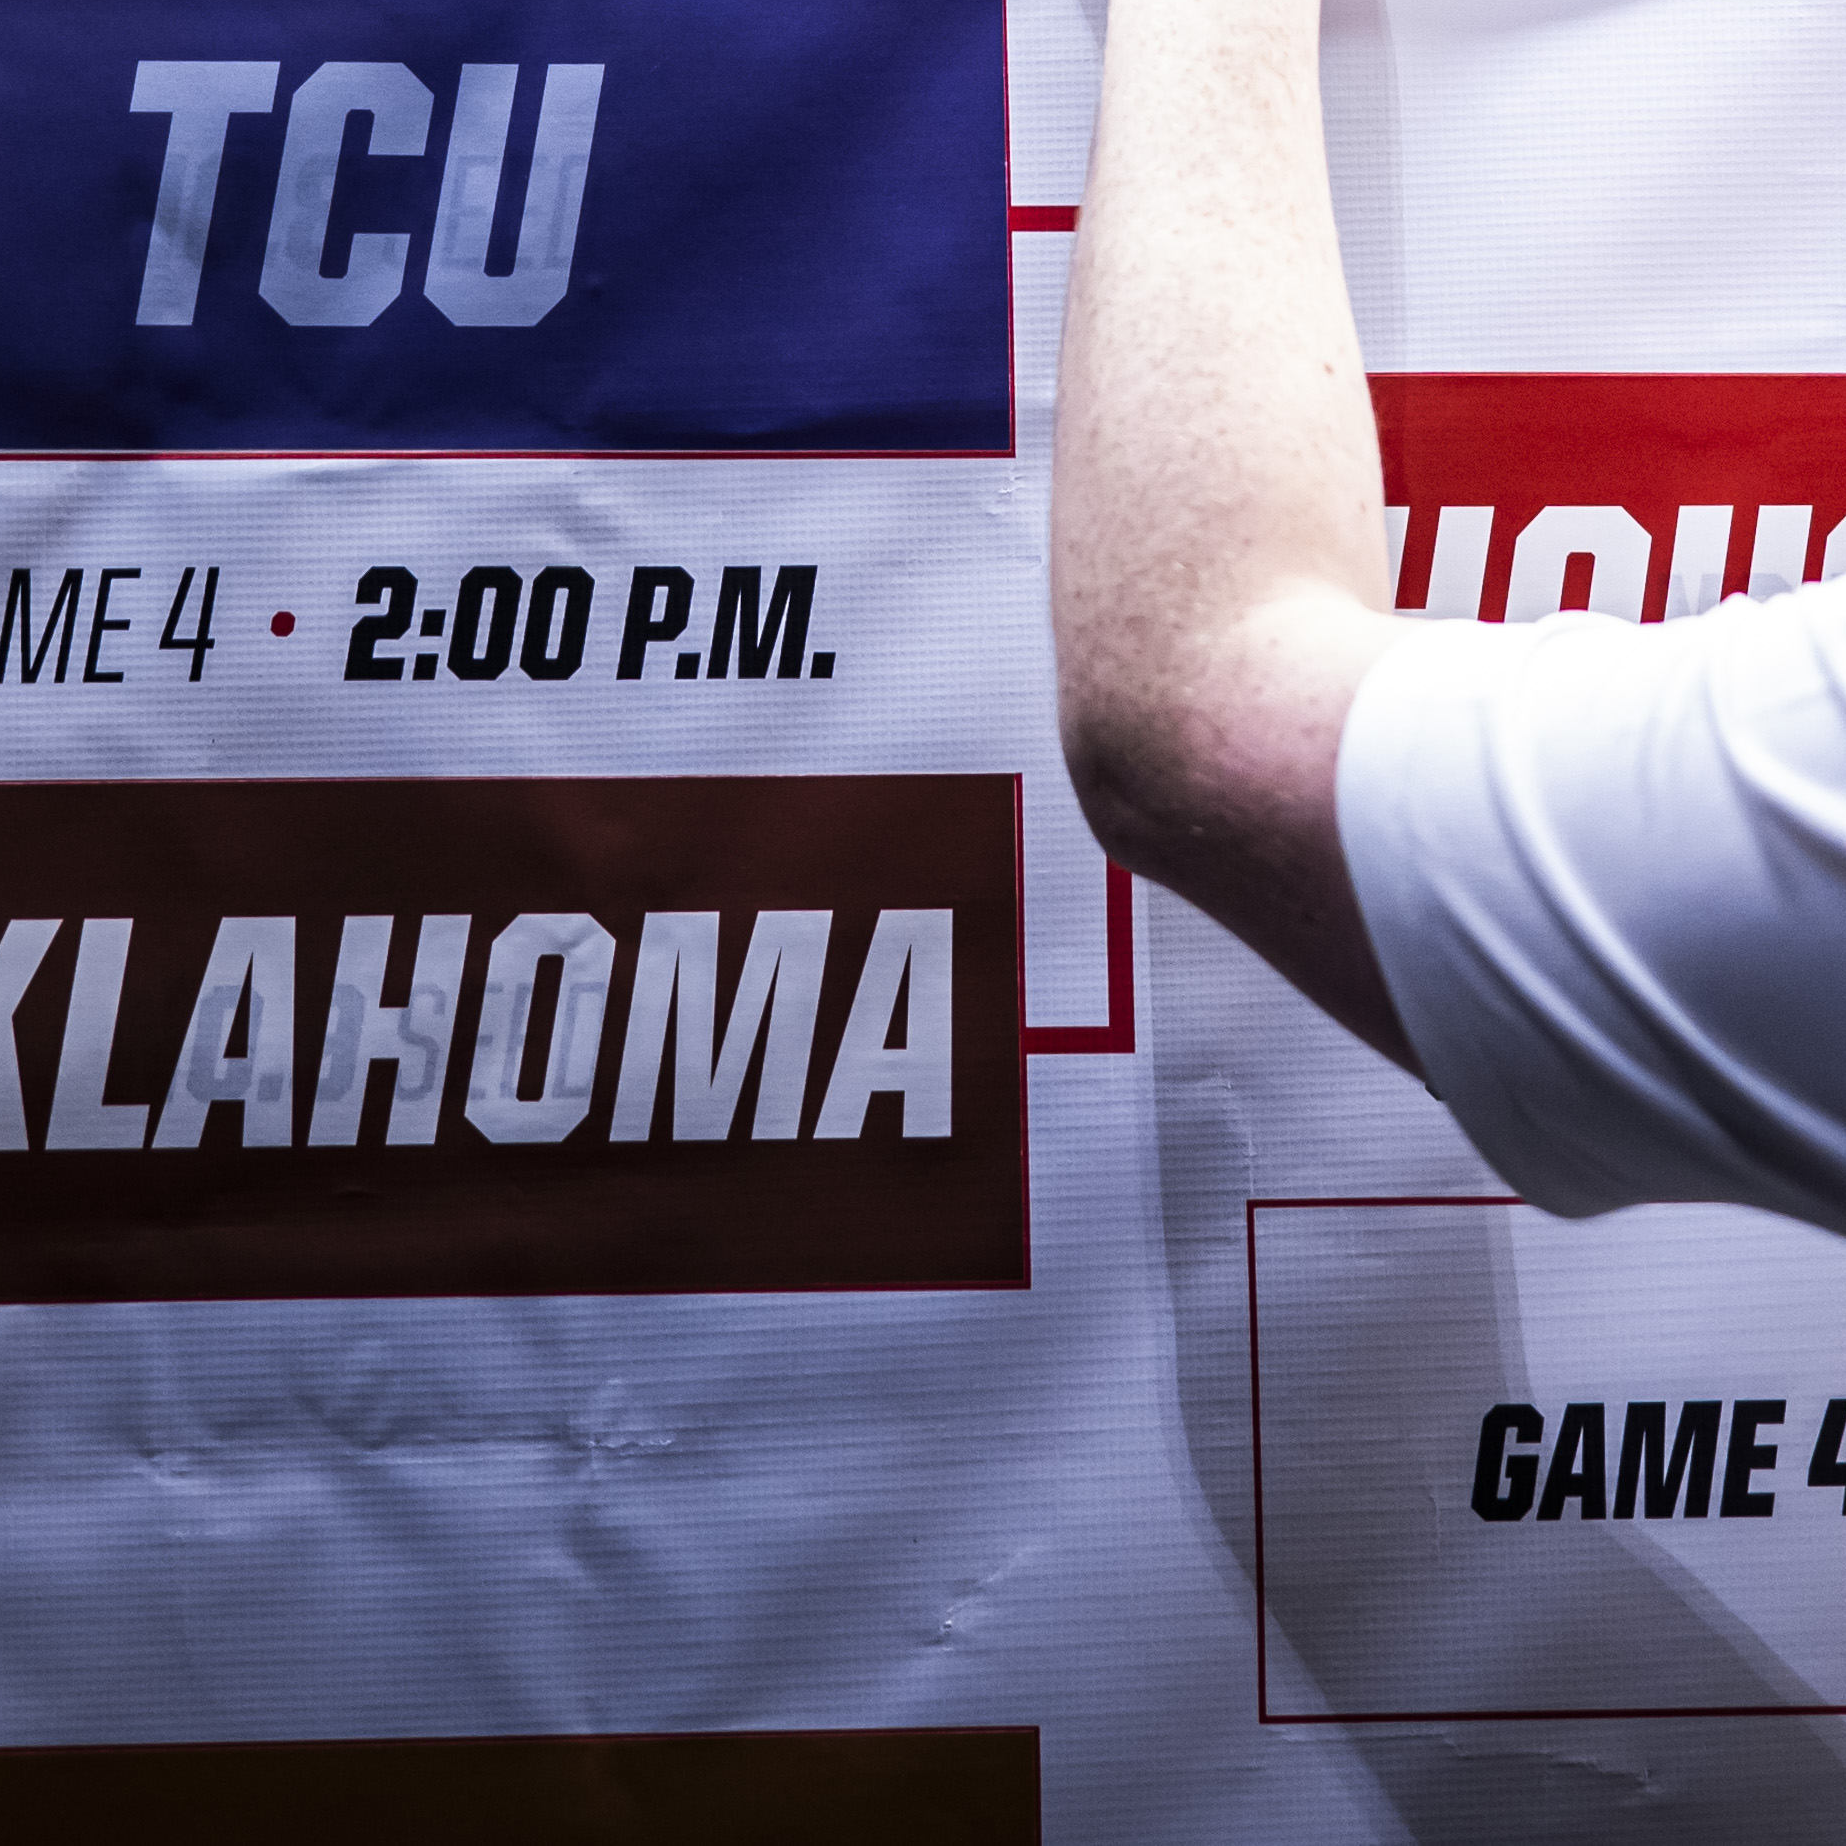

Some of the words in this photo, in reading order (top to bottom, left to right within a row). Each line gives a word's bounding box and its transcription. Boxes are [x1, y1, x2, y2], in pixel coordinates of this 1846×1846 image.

[129, 61, 605, 327] TCU
[159, 566, 220, 682] 4
[344, 565, 596, 682] 2:00
[614, 564, 837, 682] P.M.
[1470, 1399, 1787, 1522] GAME
